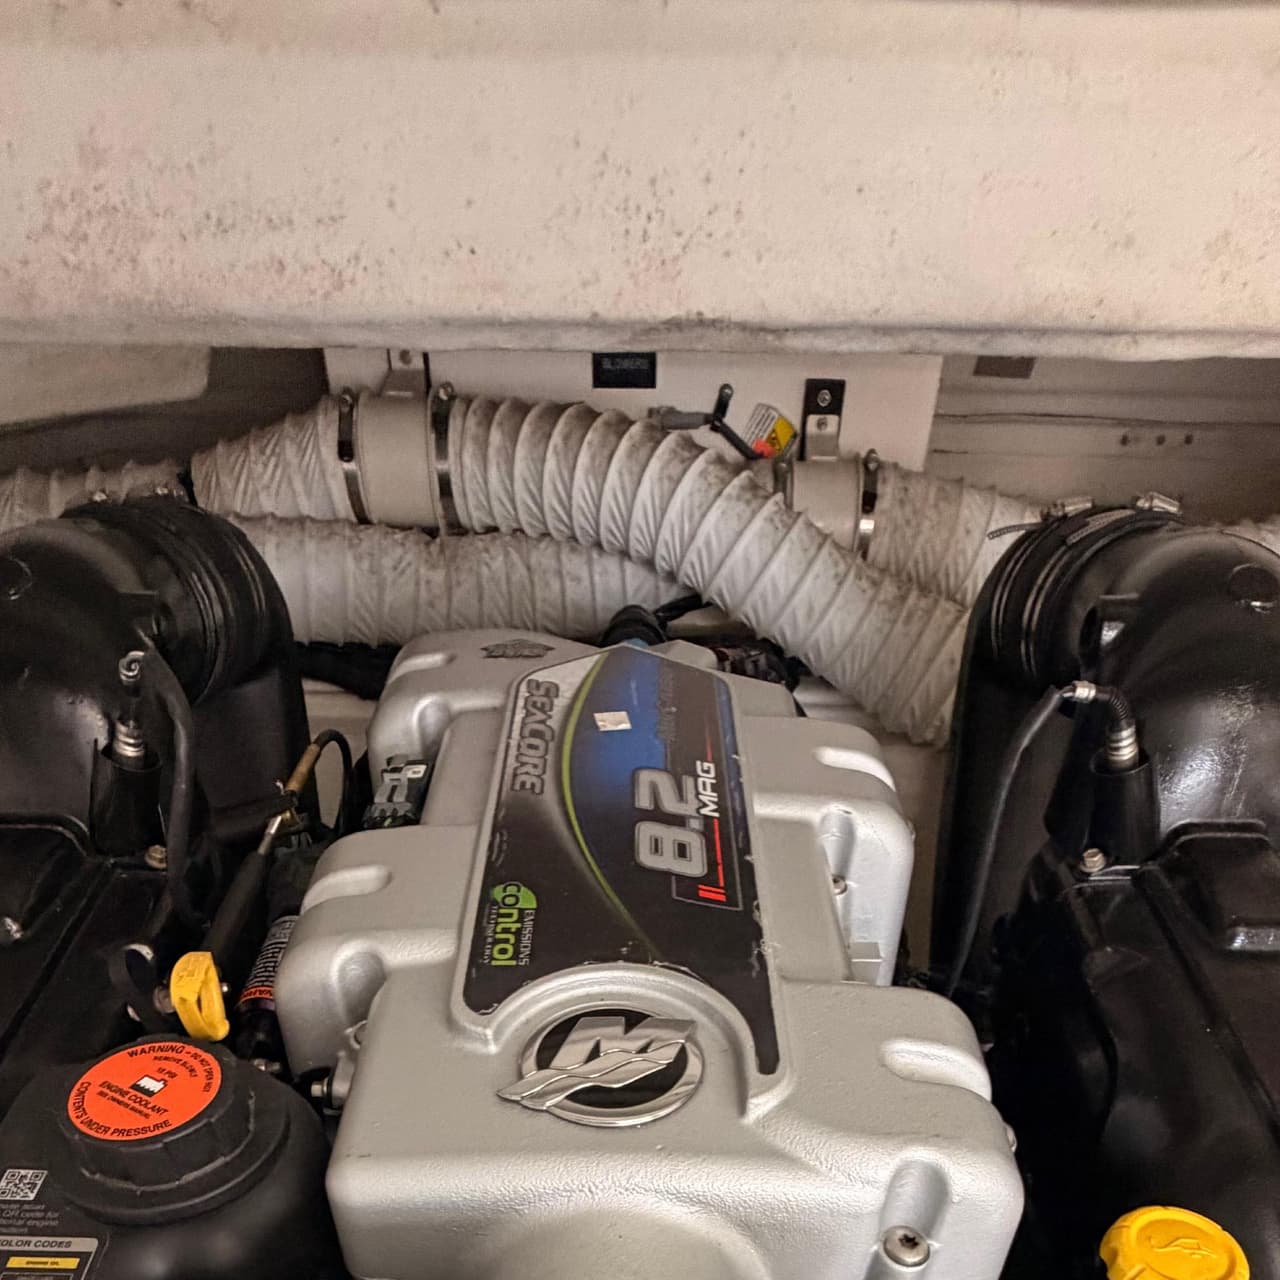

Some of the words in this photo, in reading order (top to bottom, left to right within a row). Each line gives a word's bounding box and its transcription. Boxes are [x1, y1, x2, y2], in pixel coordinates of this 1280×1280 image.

[634, 768, 707, 877] 8.2
[696, 760, 720, 817] MAG
[491, 882, 522, 966] control
[518, 909, 536, 966] EMISSIONS
[128, 1044, 185, 1058] WARNING
[73, 1081, 92, 1119] CONTENTS
[99, 1080, 130, 1097] ENGINE
[128, 1094, 168, 1115] COOLANT
[80, 1116, 111, 1134] UNDER
[111, 1120, 172, 1137] PRESSURE
[33, 1240, 72, 1249] CODES
